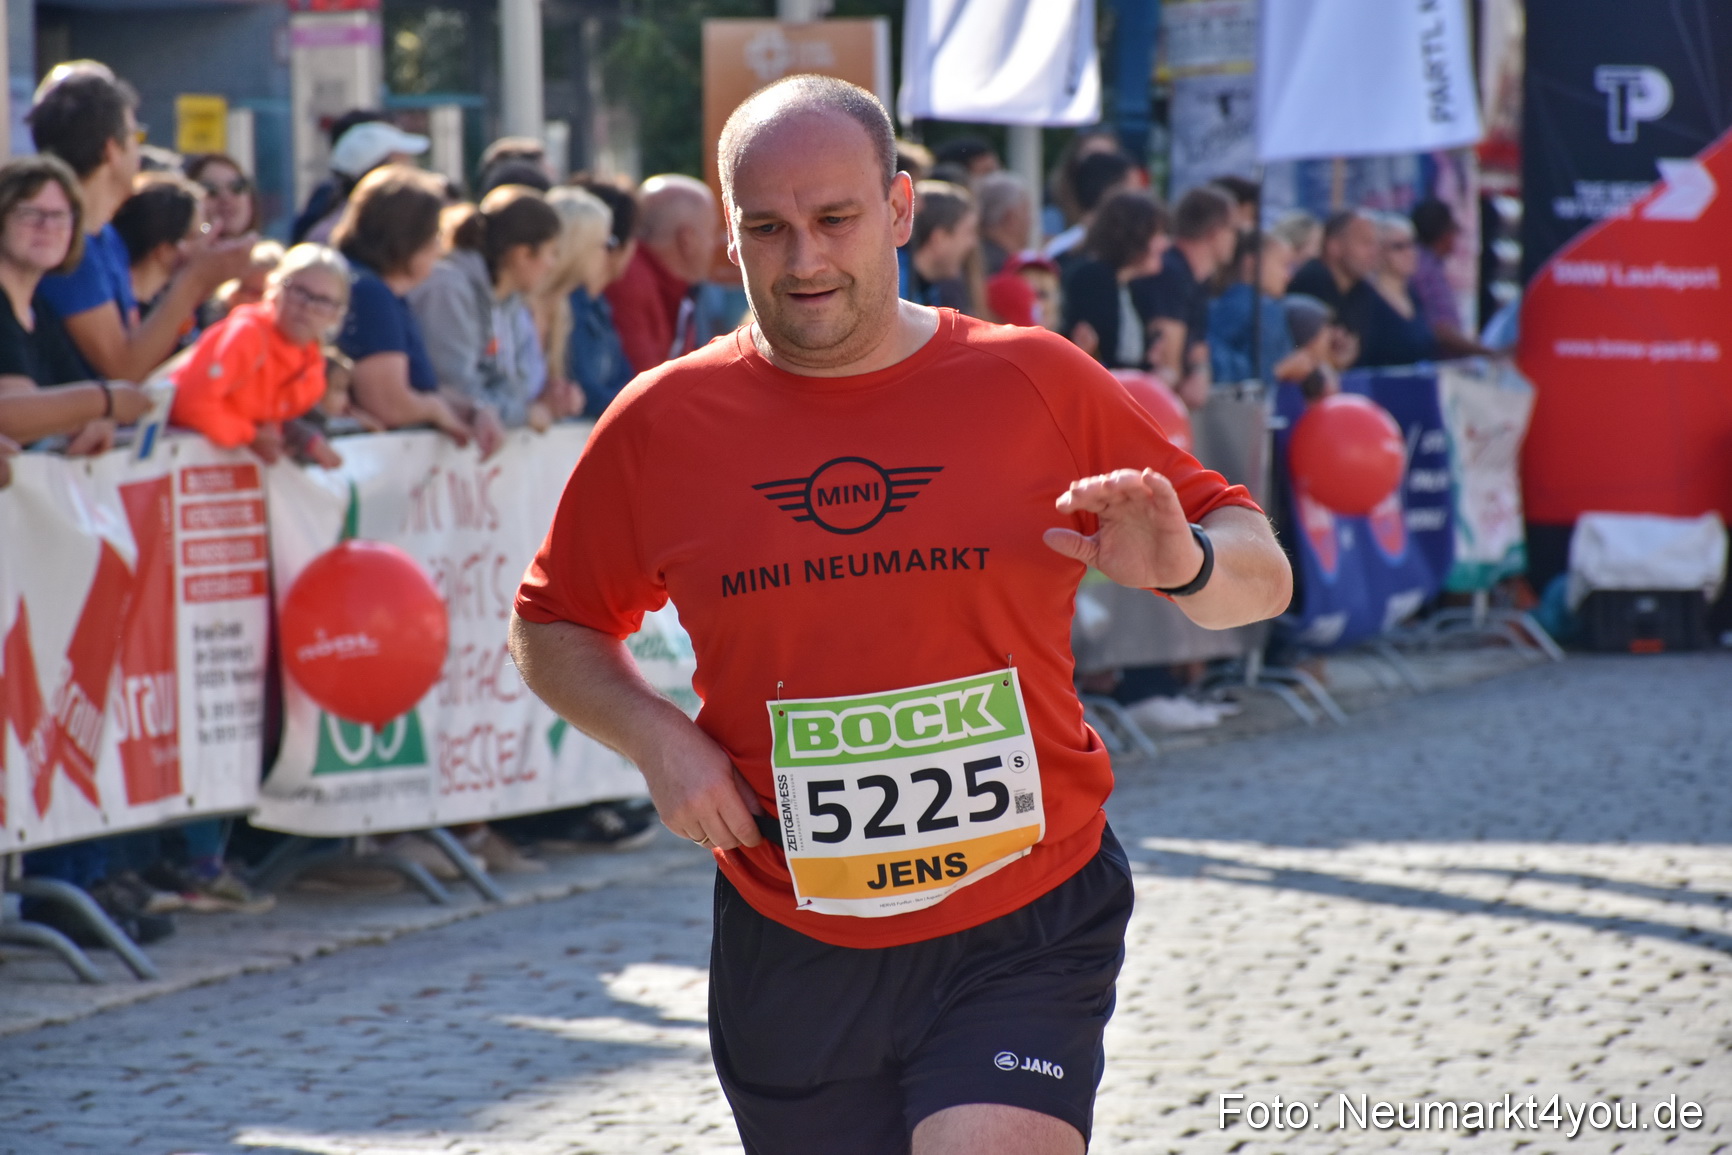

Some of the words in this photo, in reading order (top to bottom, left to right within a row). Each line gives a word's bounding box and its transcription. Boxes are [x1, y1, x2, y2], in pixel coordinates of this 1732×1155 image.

[817, 482, 880, 507] MINI
[721, 562, 791, 598] MINI
[803, 547, 990, 583] NEUMARKT
[789, 684, 1005, 759] BOCK
[1013, 756, 1024, 768] S
[807, 755, 1010, 844] 5225
[867, 852, 968, 890] JENS
[1021, 1057, 1064, 1079] JAKO
